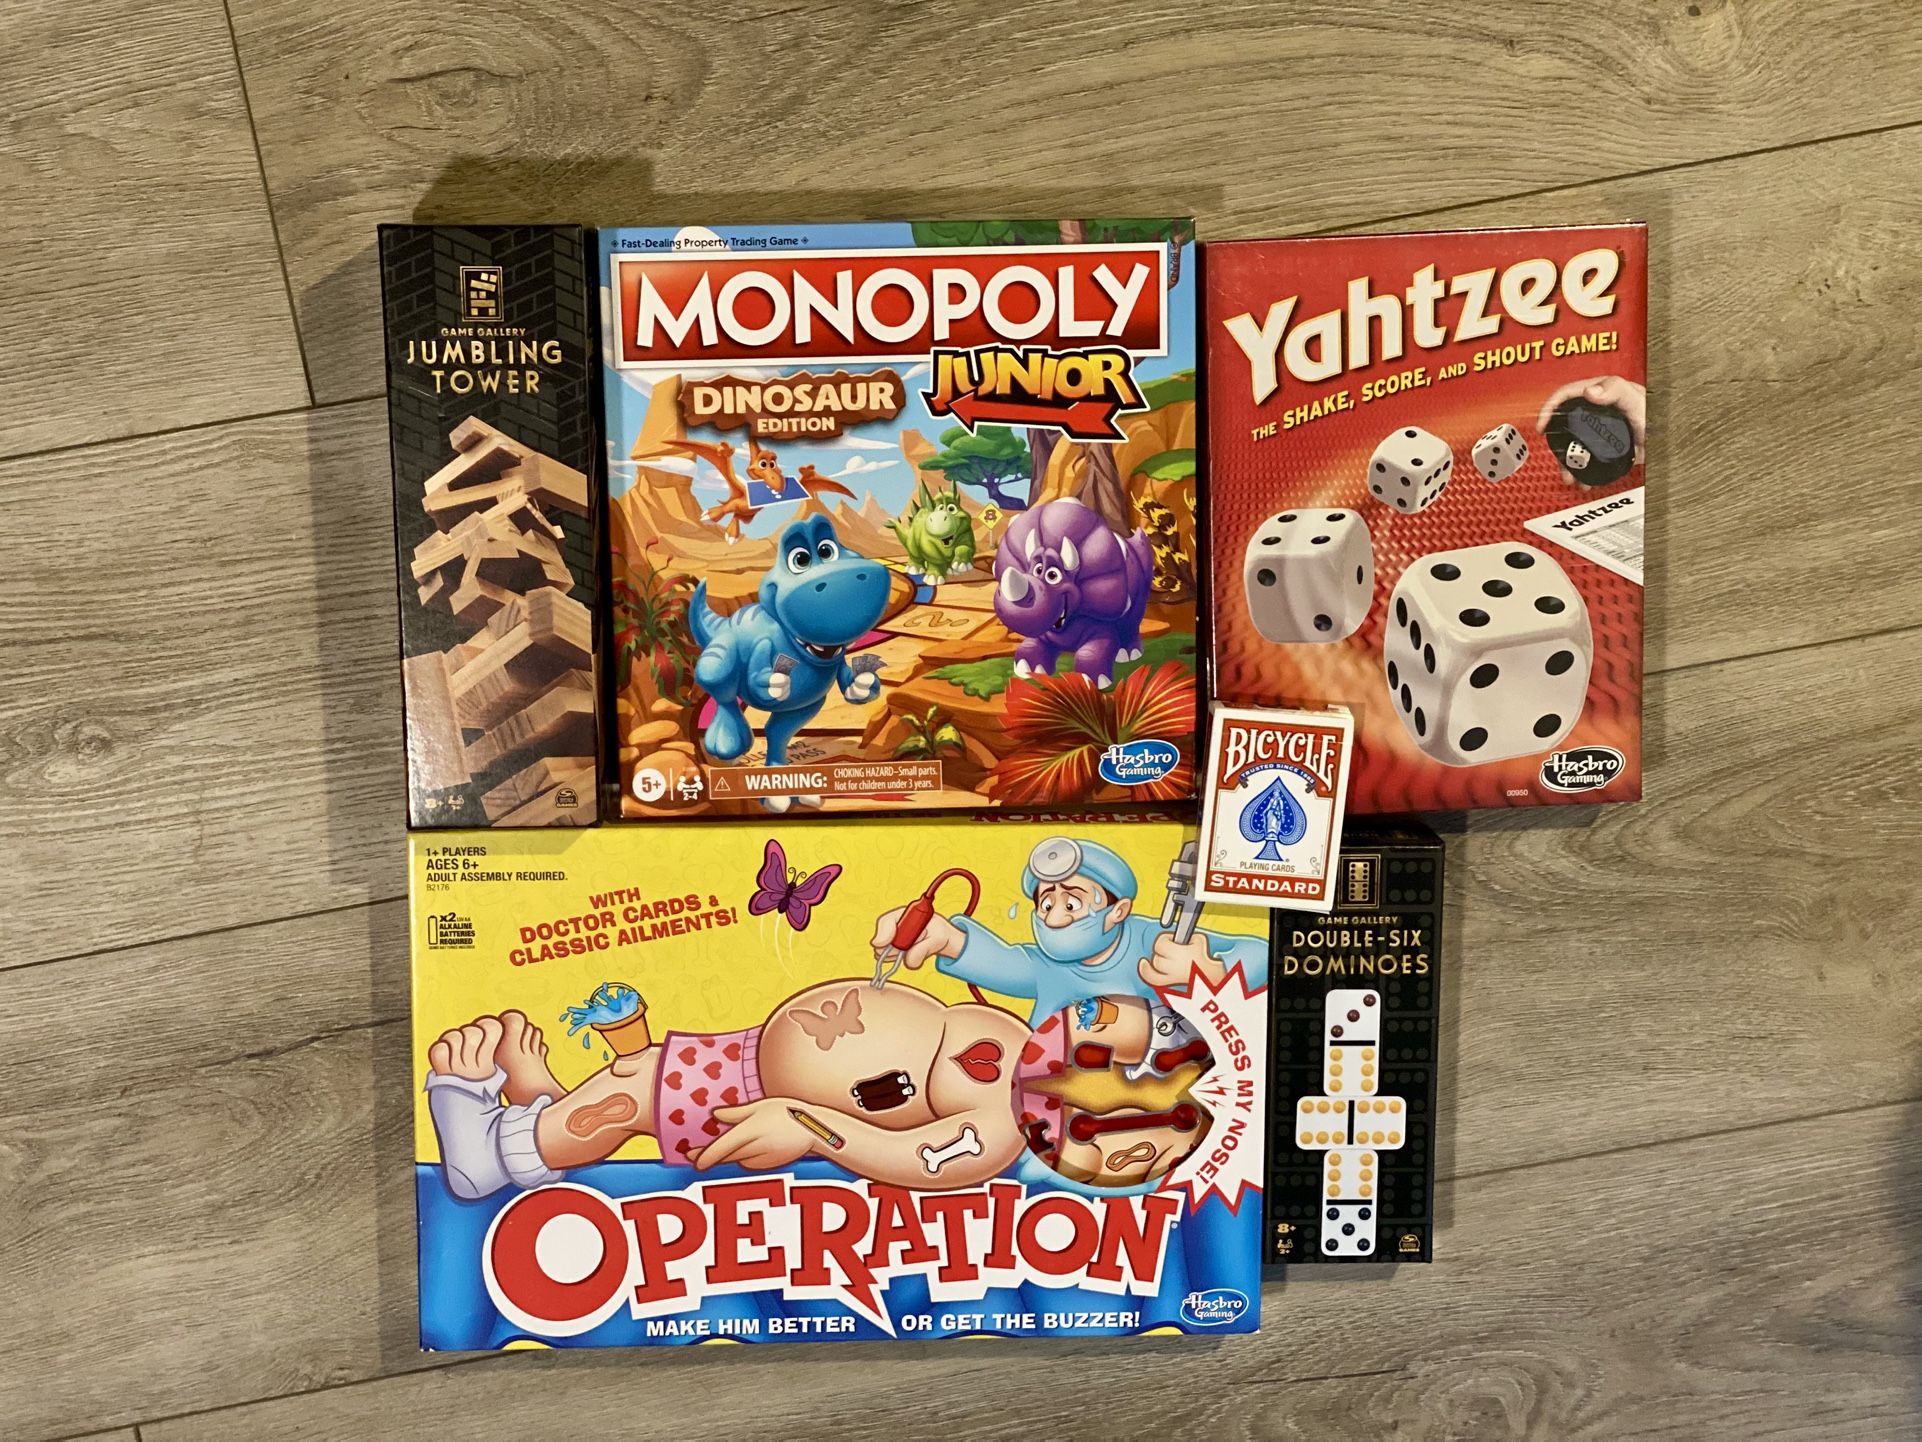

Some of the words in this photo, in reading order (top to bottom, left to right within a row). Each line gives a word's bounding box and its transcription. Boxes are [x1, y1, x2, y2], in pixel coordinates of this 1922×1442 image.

[622, 238, 681, 249] Fast-Dealing
[684, 238, 728, 249] Property
[731, 237, 767, 248] Trading
[769, 236, 799, 246] Game
[636, 262, 1151, 348] MONOPOLY
[441, 328, 474, 337] GAME
[477, 327, 526, 336] GALLERY
[1222, 248, 1620, 406] Yahtzee
[407, 340, 563, 365] JUMBLING
[431, 370, 540, 395] TOWER
[928, 348, 1140, 412] JUNIOR
[1251, 421, 1278, 442] THE
[1283, 390, 1355, 430] SHAKE,
[1361, 366, 1432, 402] SCORE,
[1438, 362, 1467, 380] AND
[1473, 340, 1545, 372] SHOUT
[1551, 331, 1618, 357] GAME!
[693, 381, 897, 415] DINOSAUR
[757, 416, 835, 434] EDITION
[1552, 497, 1635, 532] Yahtzee
[1103, 745, 1172, 768] Hasbro
[1223, 727, 1337, 792] BICYCLE
[1544, 754, 1618, 775] Hasbro
[834, 767, 865, 778] CHOKING
[918, 766, 938, 778] parts.
[1115, 763, 1164, 778] Gaming
[1241, 763, 1275, 778] TRUSTED
[1276, 763, 1298, 773] SINCE
[1557, 771, 1605, 786] Gaming
[642, 777, 661, 793] 5+
[745, 773, 828, 790] WARNING:
[834, 781, 847, 790] Not
[848, 780, 857, 790] for
[859, 779, 885, 789] children
[887, 779, 907, 789] under
[908, 778, 913, 788] 3
[914, 779, 934, 790] years.
[683, 792, 698, 801] 2-4
[970, 810, 1176, 824] PERATION
[426, 848, 439, 856] 1+
[442, 847, 486, 857] PLAYERS
[426, 859, 459, 870] AGES
[462, 858, 479, 870] 6+
[1239, 861, 1270, 872] PLAYING
[1271, 862, 1296, 874] CARDS
[426, 872, 458, 882] ADULT
[460, 871, 513, 882] ASSEMBLY
[516, 871, 569, 881] REQUIRED.
[1210, 873, 1321, 895] STANDARD
[426, 884, 450, 892] B2176
[588, 887, 641, 910] WITH
[440, 912, 456, 922] x2
[519, 910, 617, 944] DOCTOR
[622, 893, 702, 924] CARDS
[708, 894, 720, 908] &
[1318, 917, 1348, 925] GAME
[1352, 916, 1399, 925] GALLERY
[439, 930, 476, 938] BATTERIES
[509, 932, 610, 967] CLASSIC
[617, 906, 739, 947] AILMENTS!
[1292, 929, 1422, 948] DOUBLE-SIX
[1283, 953, 1429, 976] DOMINOES
[1200, 999, 1252, 1073] PRESS
[1235, 1079, 1255, 1113] MY
[1195, 1117, 1248, 1185] NOSE!
[1277, 1223, 1297, 1233] 8+
[490, 1178, 1179, 1323] OPERATION
[1184, 1294, 1243, 1312] Hasbro
[1195, 1307, 1234, 1321] Gaming
[646, 1320, 712, 1337] MAKE
[718, 1318, 760, 1336] HIM
[767, 1316, 856, 1334] BETTER
[901, 1313, 933, 1331] OR
[940, 1313, 986, 1330] GET
[992, 1312, 1036, 1329] THE
[1043, 1311, 1141, 1329] BUZZER!
